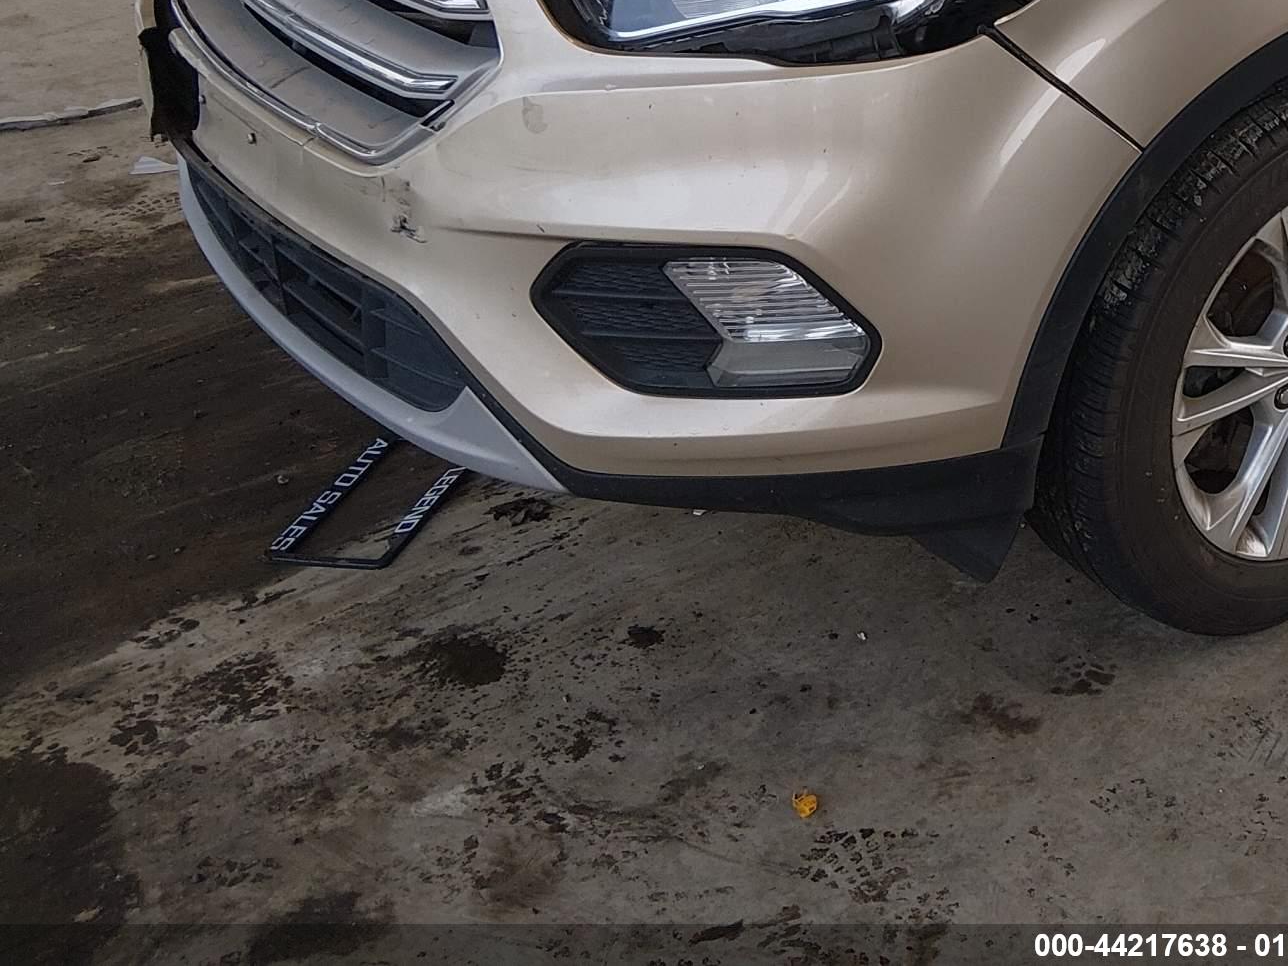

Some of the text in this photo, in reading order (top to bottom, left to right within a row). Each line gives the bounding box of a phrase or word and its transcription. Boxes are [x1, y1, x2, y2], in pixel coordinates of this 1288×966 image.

[269, 437, 389, 552] AUTO SALES
[394, 466, 467, 534] LEGEND
